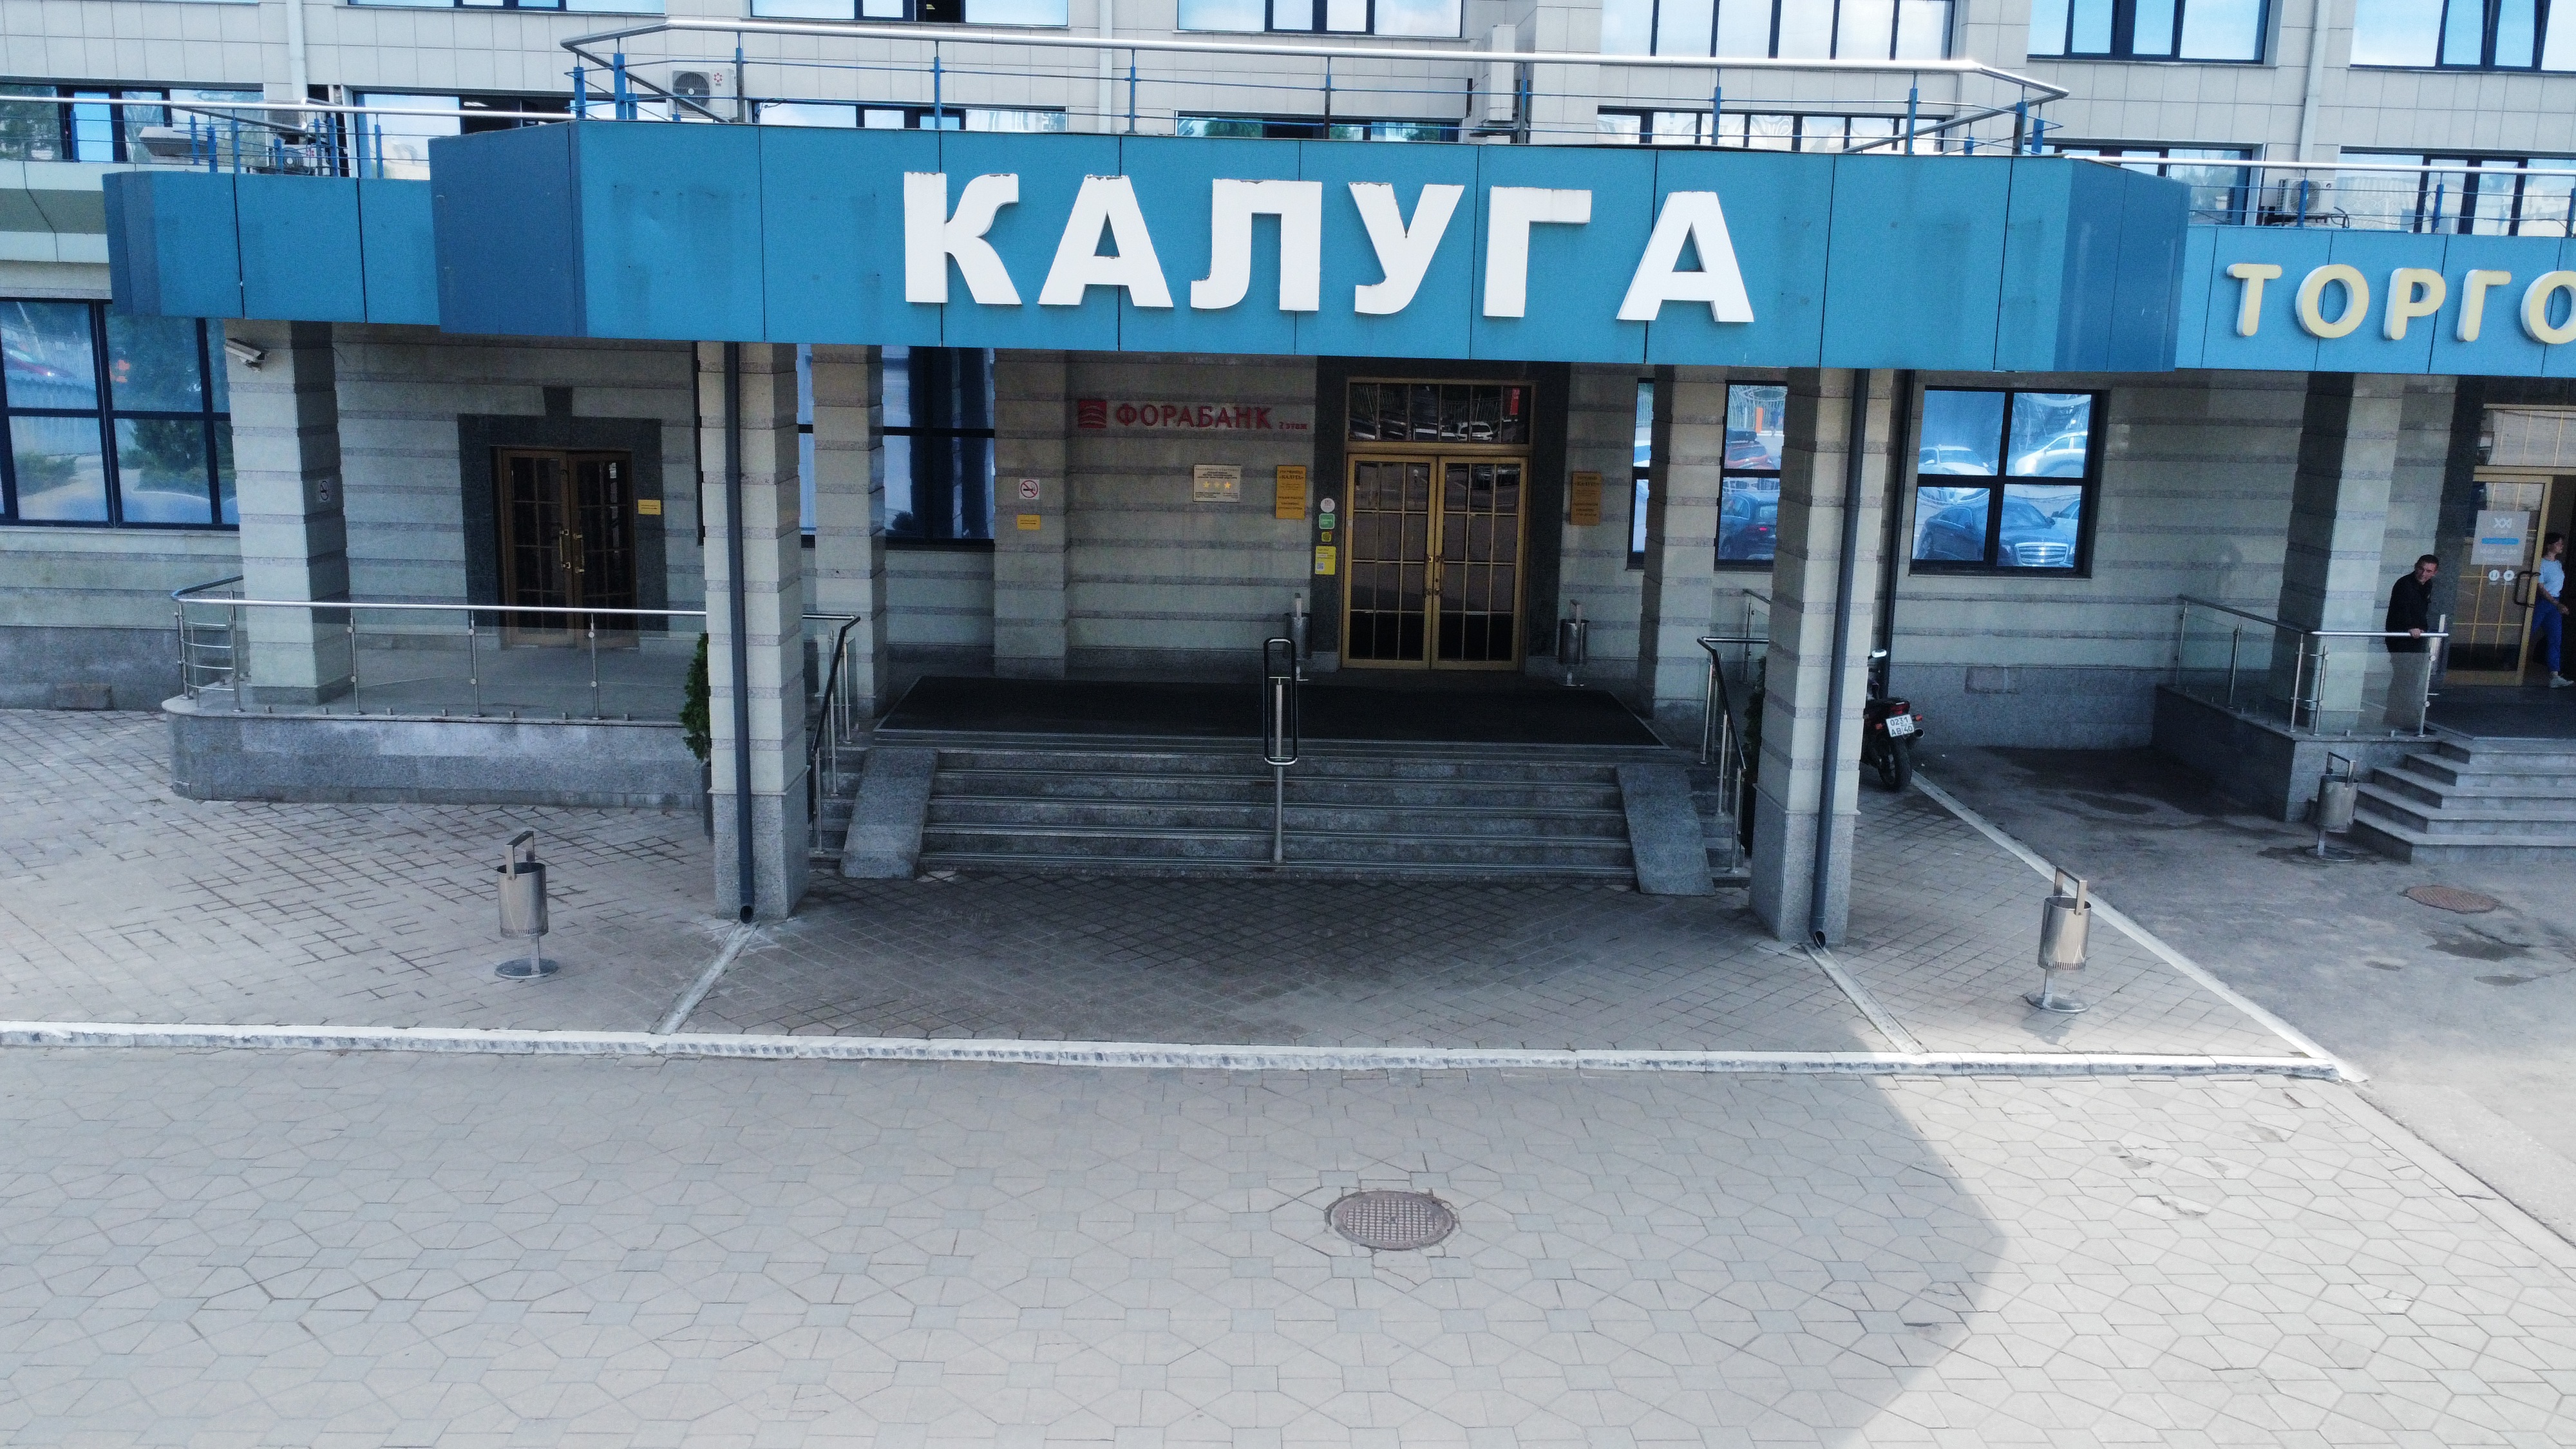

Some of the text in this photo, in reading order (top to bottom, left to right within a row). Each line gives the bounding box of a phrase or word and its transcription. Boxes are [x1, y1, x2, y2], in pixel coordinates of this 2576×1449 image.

[903, 171, 1756, 324] КАЛУГА
[2226, 263, 2576, 345] ТОРГО
[1115, 402, 1273, 430] ФОРАБАНК
[1890, 716, 1908, 726] 0231
